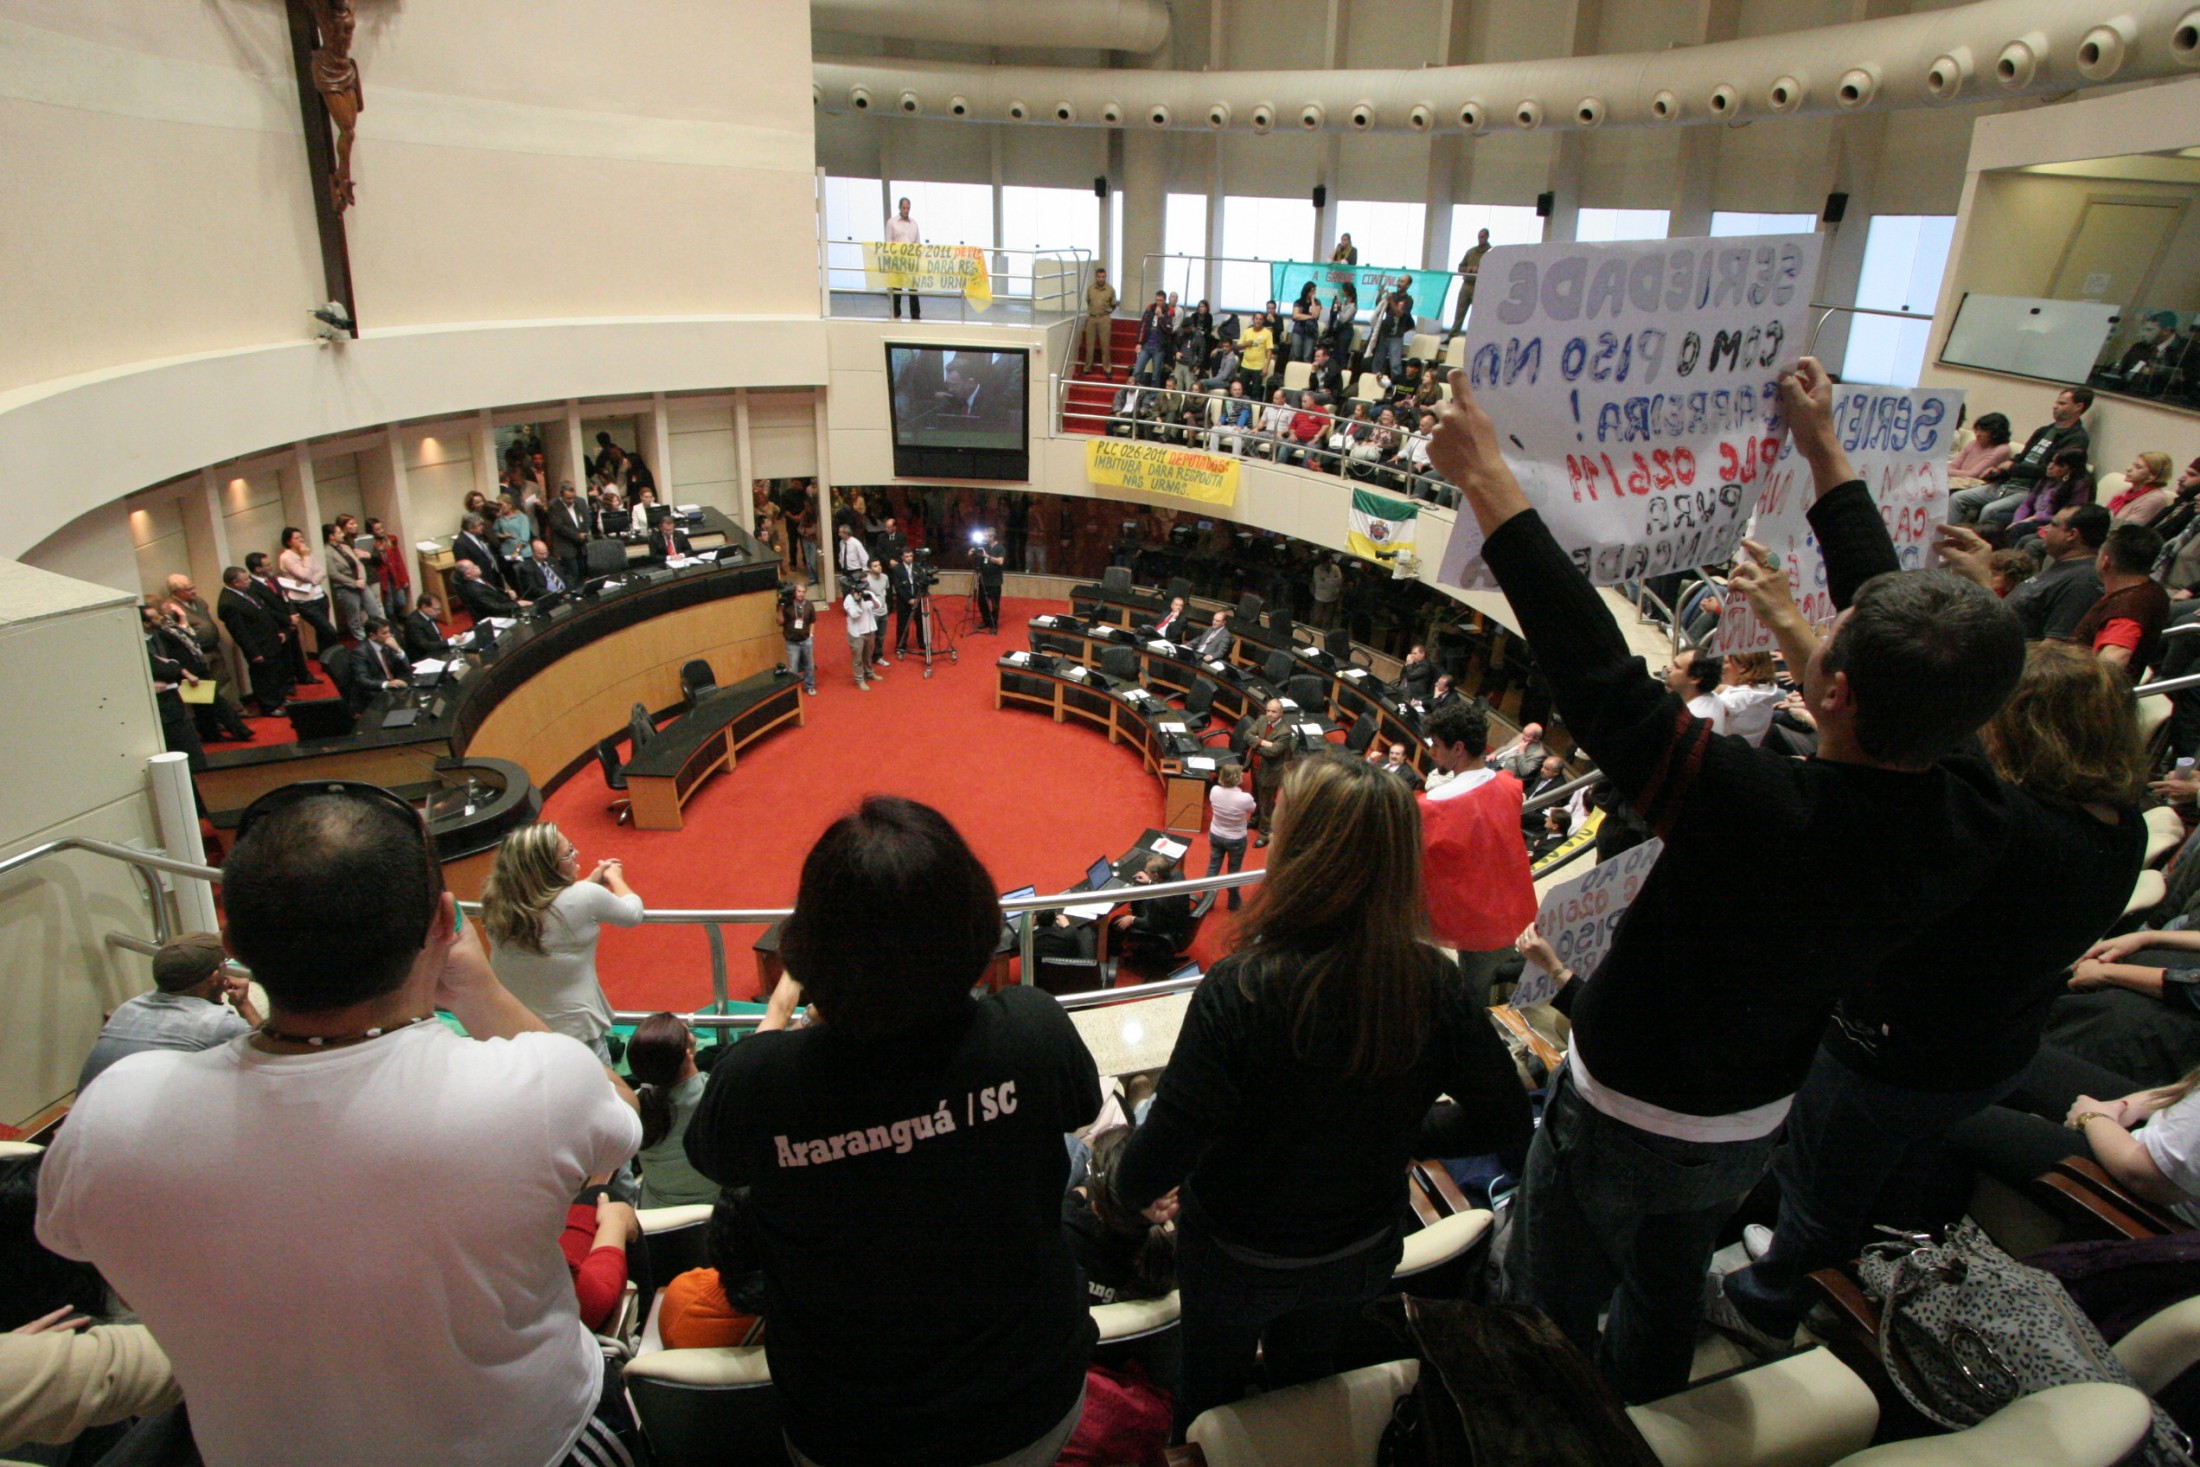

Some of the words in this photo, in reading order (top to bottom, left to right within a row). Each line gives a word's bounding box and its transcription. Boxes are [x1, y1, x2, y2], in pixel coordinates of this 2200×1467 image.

[875, 242, 897, 255] PLC
[911, 275, 934, 288] NAS
[1096, 440, 1119, 458] PLC
[1094, 455, 1142, 474] IMBITUBA
[1176, 467, 1224, 488] RESPOSTA
[1122, 474, 1145, 489] NAS
[774, 1099, 956, 1168] Araranguá
